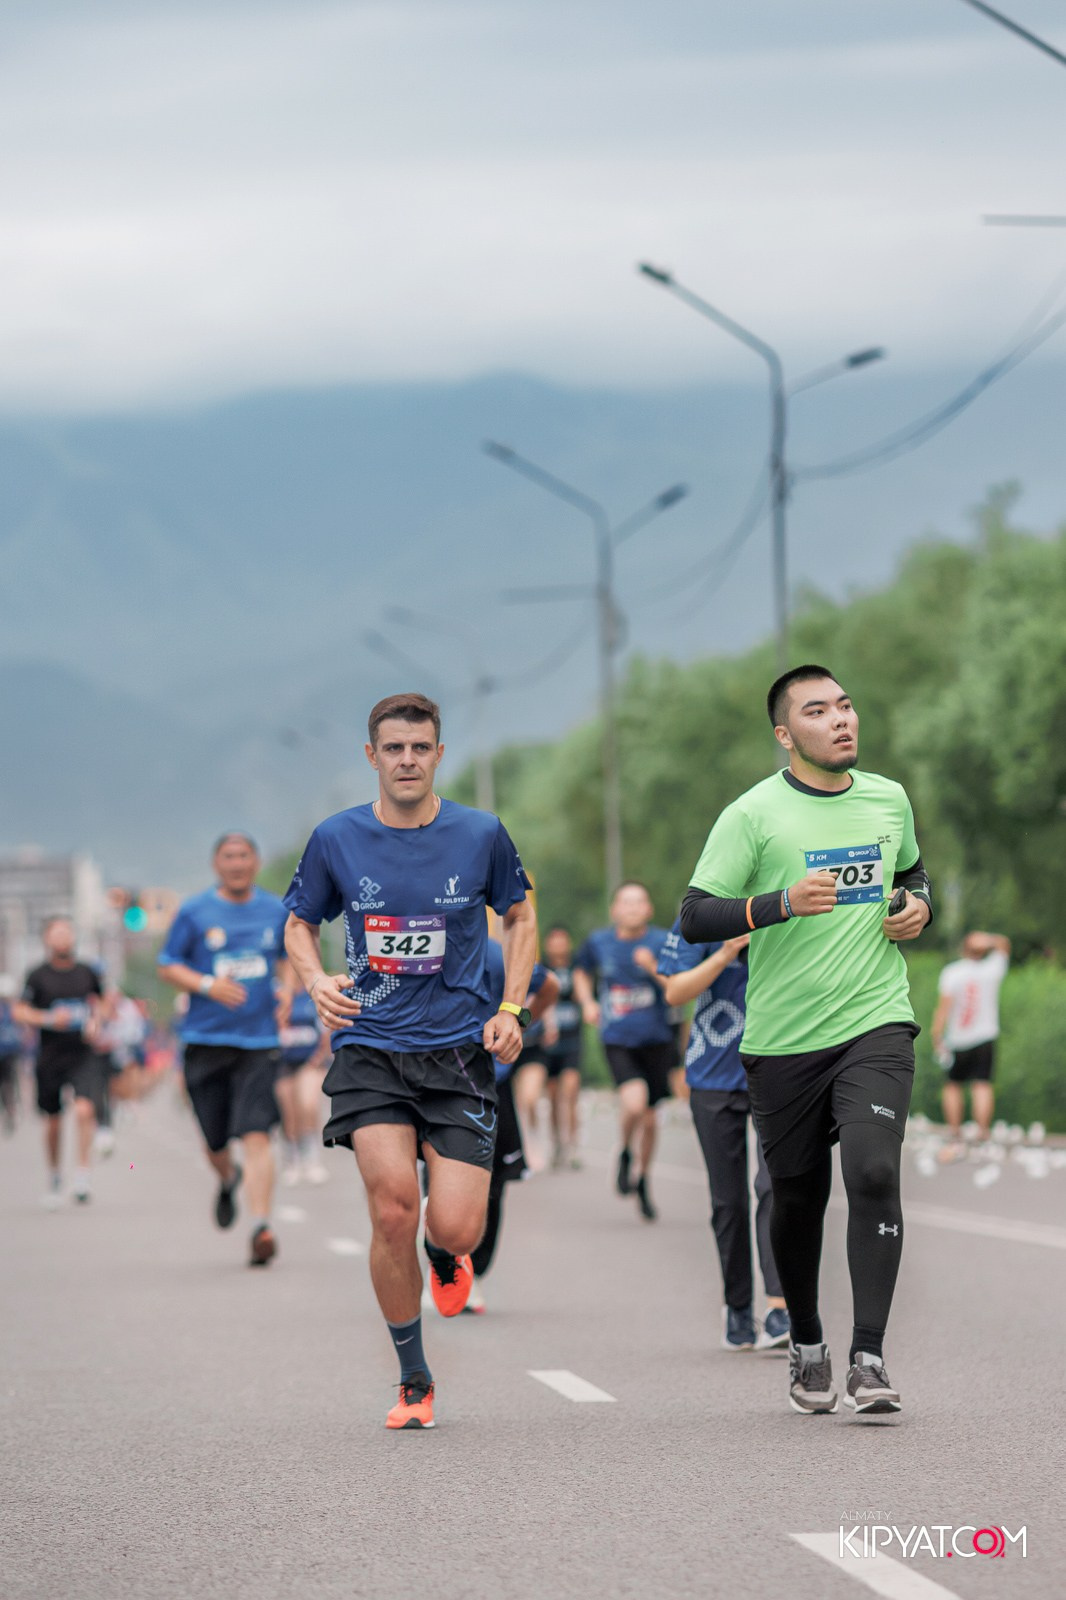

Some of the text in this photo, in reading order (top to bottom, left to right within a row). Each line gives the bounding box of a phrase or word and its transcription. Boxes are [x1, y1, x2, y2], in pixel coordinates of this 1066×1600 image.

[809, 854, 815, 862] 5
[818, 864, 875, 886] 703
[360, 901, 385, 910] GROUP
[368, 919, 378, 927] 10
[380, 934, 432, 956] 342
